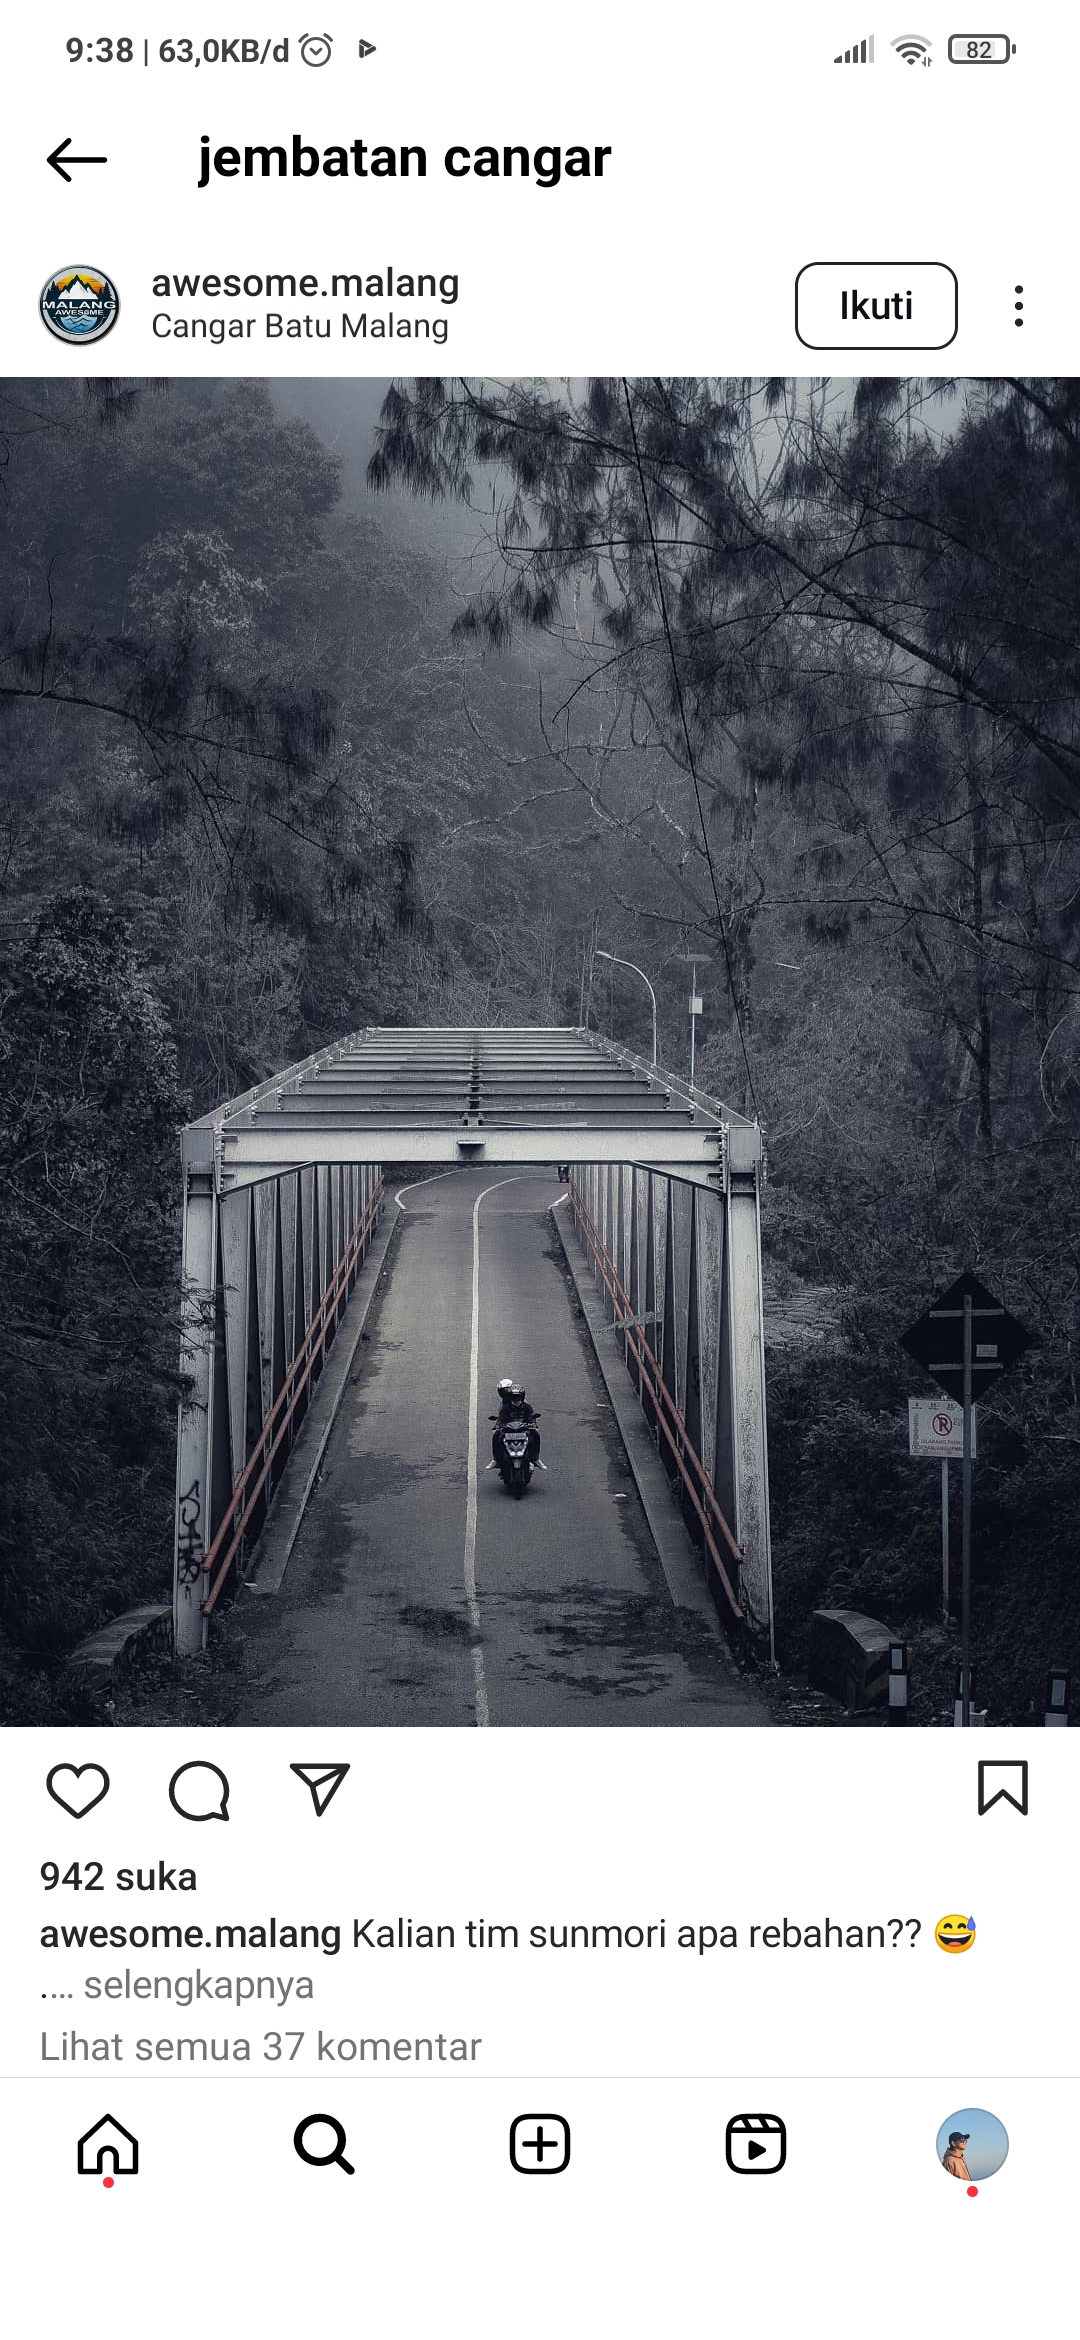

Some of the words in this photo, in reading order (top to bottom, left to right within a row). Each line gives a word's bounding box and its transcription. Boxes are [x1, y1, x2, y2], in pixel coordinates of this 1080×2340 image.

[66, 37, 133, 62] 9:38
[159, 38, 288, 68] 63,0KB/d
[967, 41, 991, 58] 82
[198, 135, 427, 188] jembatan
[444, 146, 612, 188] cangar
[153, 267, 459, 303] awesome.malang
[42, 301, 116, 309] MALANG
[841, 290, 913, 320] Ikuti
[153, 313, 256, 344] Cangar
[267, 313, 330, 338] Batu
[343, 312, 447, 344] Malang
[40, 1862, 105, 1891] 942
[116, 1861, 197, 1891] suka
[41, 1918, 341, 1955] awesome.malang
[354, 1918, 455, 1949] Kalian
[465, 1919, 519, 1949] tim
[530, 1919, 666, 1949] sunmori
[678, 1926, 737, 1956] apa
[750, 1918, 922, 1949] rebahan??
[85, 1969, 314, 2006] selengkapnya
[41, 2031, 123, 2061] Lihat
[136, 2039, 251, 2061] semua
[263, 2032, 305, 2061] 37
[319, 2031, 483, 2061] komentar
